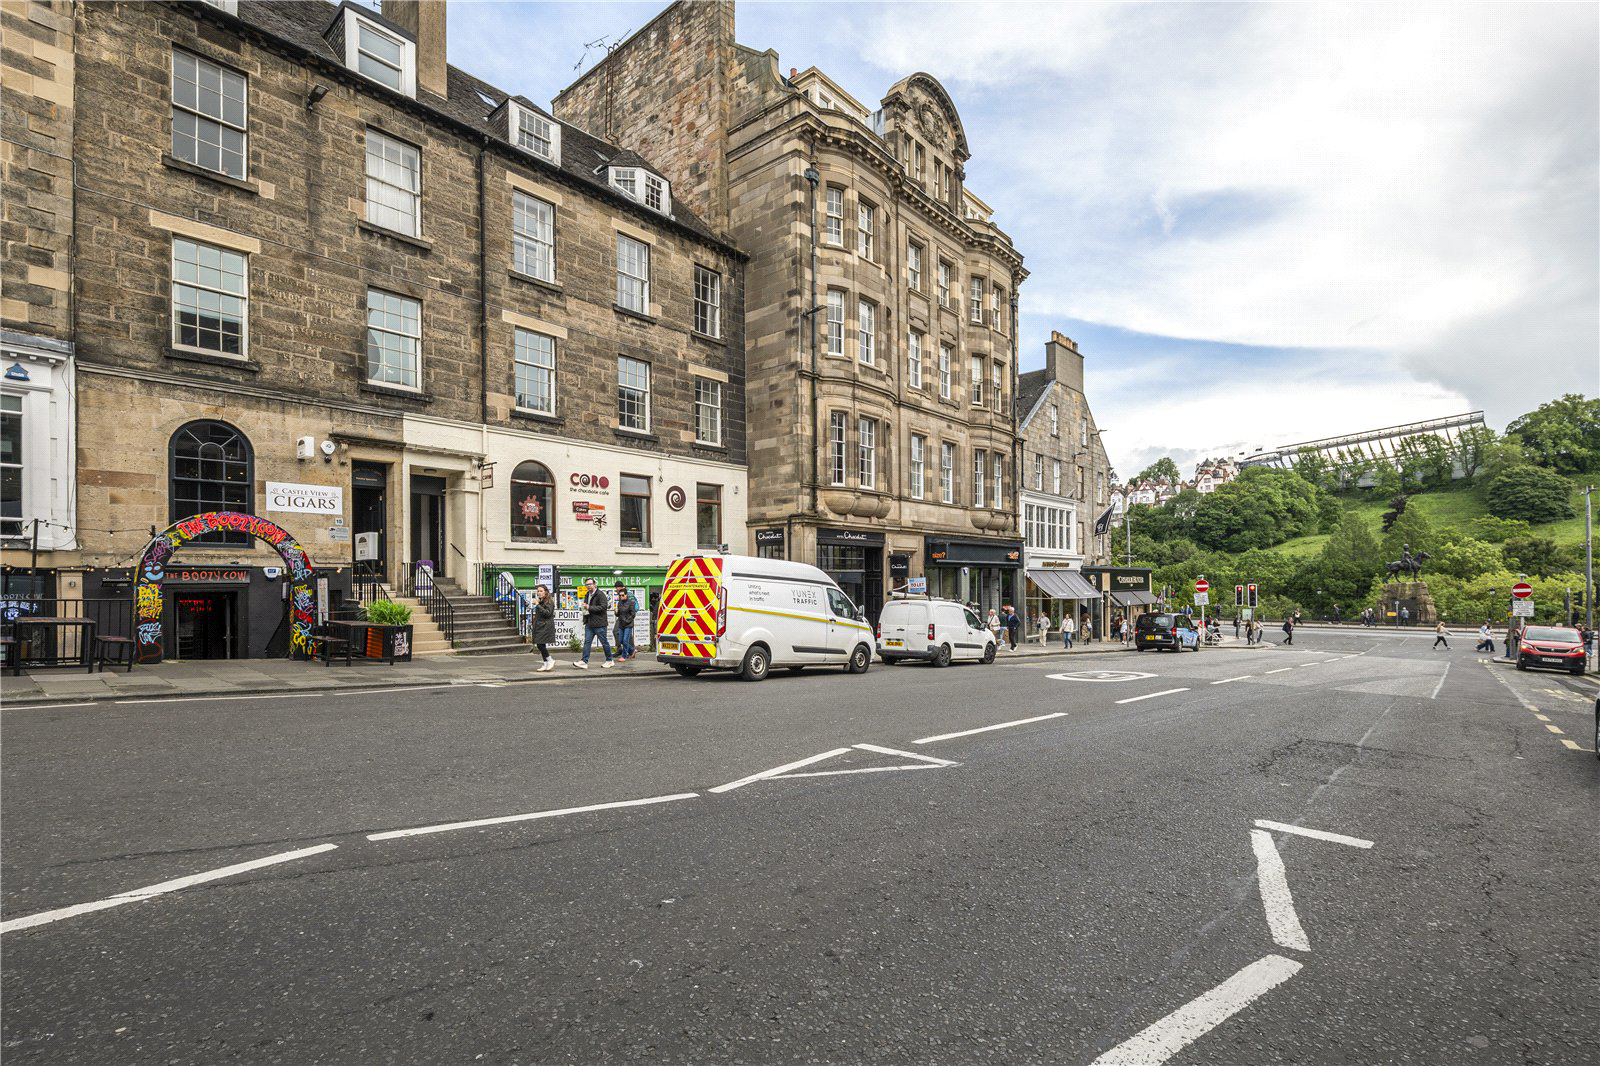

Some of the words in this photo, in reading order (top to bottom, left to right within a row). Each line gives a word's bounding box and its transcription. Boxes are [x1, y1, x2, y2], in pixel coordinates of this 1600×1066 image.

[570, 473, 609, 489] CORO
[274, 495, 336, 510] CIGARS
[205, 513, 258, 532] BOOZY
[257, 522, 287, 545] COW
[182, 571, 220, 581] BOOZY
[223, 570, 247, 582] COW
[793, 598, 817, 606] TRAFFIC
[559, 611, 579, 619] POINT
